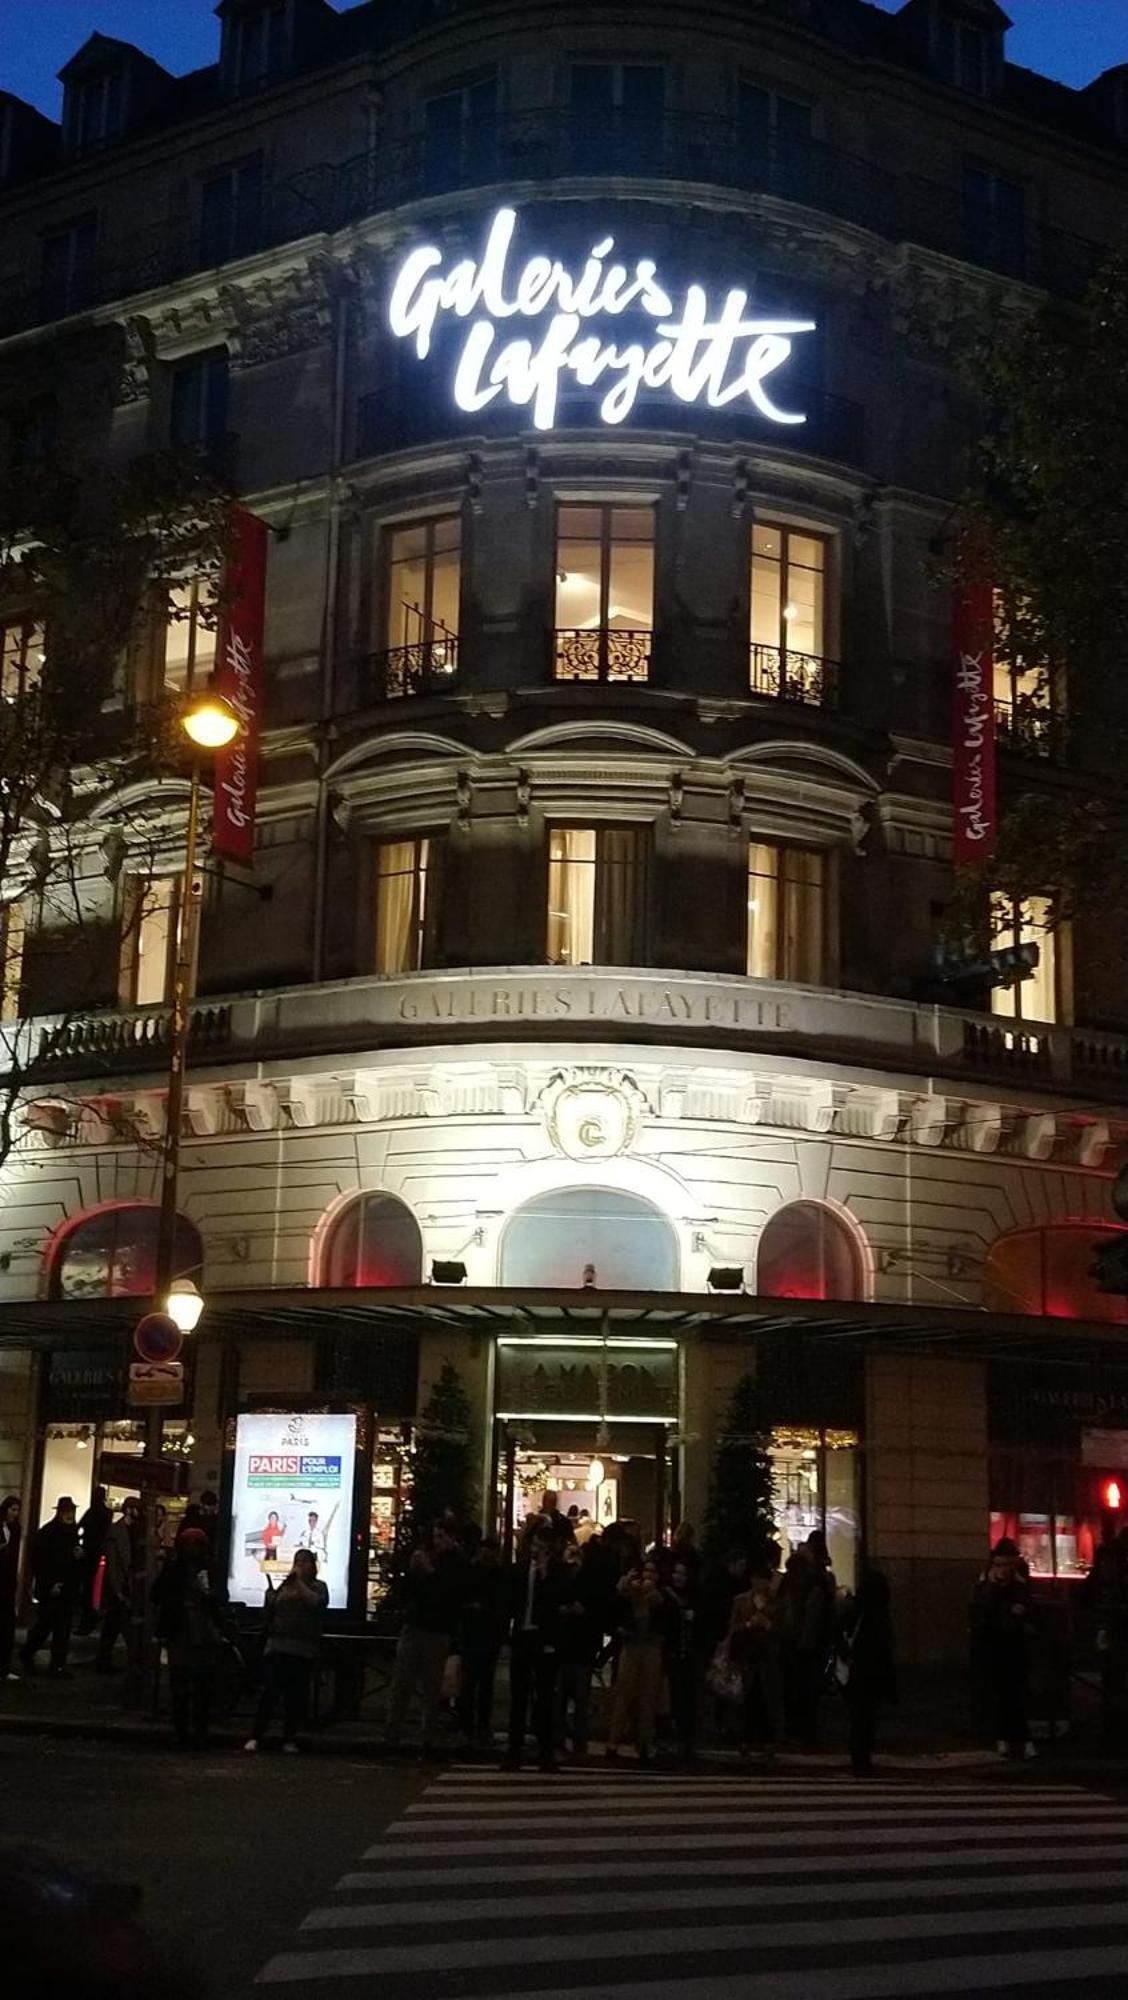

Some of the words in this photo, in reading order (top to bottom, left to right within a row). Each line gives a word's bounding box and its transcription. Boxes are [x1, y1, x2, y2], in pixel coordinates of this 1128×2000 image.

[390, 208, 673, 360] Galeries
[454, 285, 817, 430] Lafayette
[956, 650, 989, 748] Lafayette
[959, 753, 991, 840] Galeries
[400, 988, 571, 1020] GALERIES
[589, 988, 792, 1029] LAFAYETTE
[250, 1457, 297, 1473] PARIS
